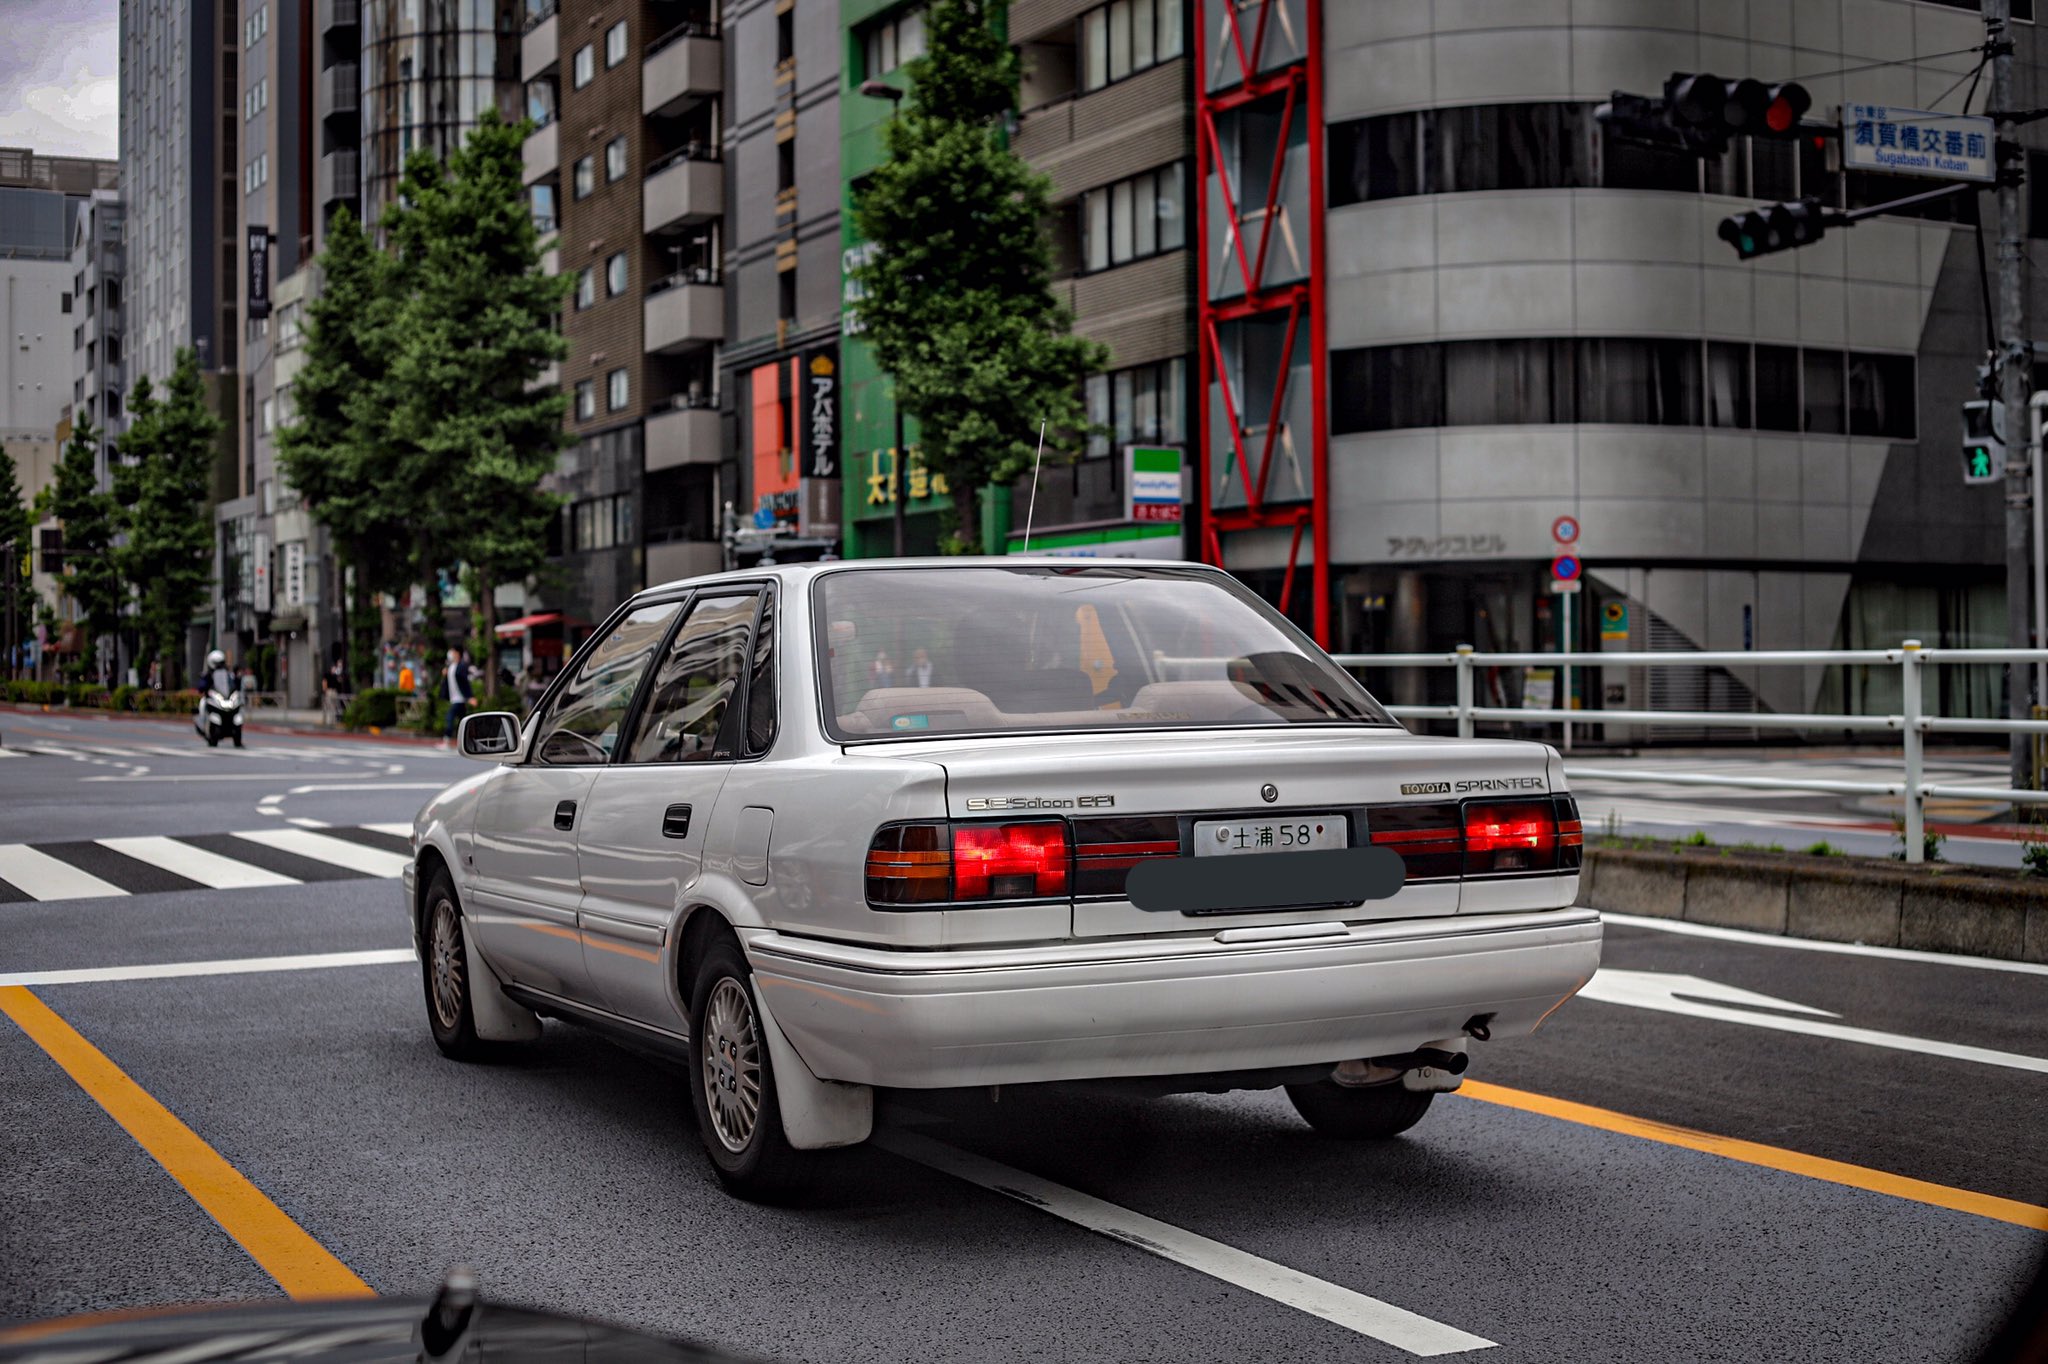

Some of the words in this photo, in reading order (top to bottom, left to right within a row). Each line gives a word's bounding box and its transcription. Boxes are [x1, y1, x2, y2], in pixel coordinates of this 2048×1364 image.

[1855, 119, 1986, 159] 須賀橋交番前
[1875, 149, 1930, 168] Sugabashi
[1934, 157, 1969, 171] Koban
[811, 377, 834, 476] アパホテル
[1404, 783, 1449, 794] TOYOTA
[1455, 777, 1544, 793] SPRINTER
[1232, 826, 1273, 849] 土浦
[1280, 824, 1311, 846] 58
